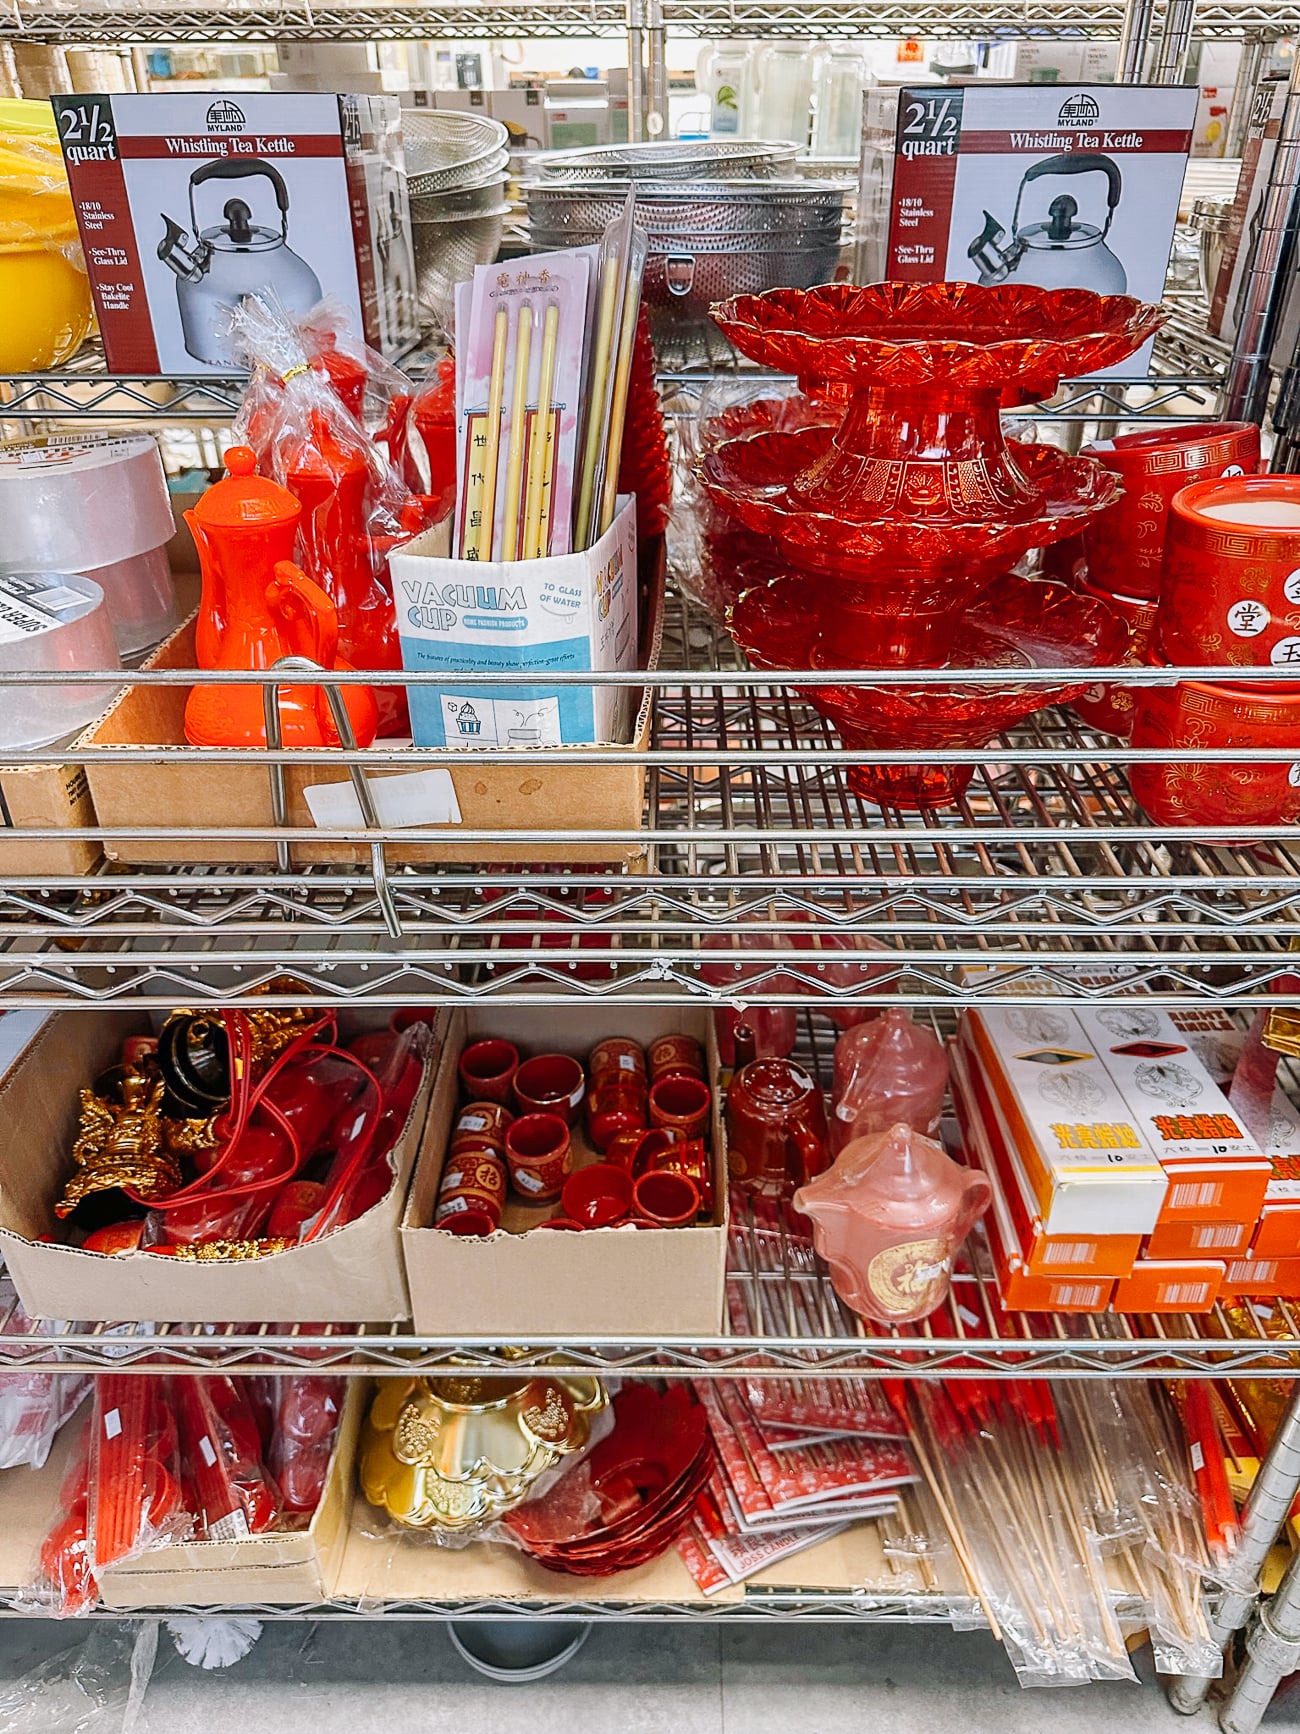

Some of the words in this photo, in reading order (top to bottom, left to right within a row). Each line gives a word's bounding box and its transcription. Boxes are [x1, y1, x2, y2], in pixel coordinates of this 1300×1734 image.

[1057, 119, 1094, 127] MYLAND
[207, 124, 243, 132] MYLAND
[1010, 132, 1073, 152] Whistling
[1076, 132, 1101, 148] Tea
[1102, 132, 1143, 148] Kettle
[165, 137, 228, 157] Whistling
[229, 137, 254, 153] Tea
[255, 137, 295, 153] Kettle
[902, 137, 955, 161] quart
[66, 143, 117, 167] quart
[81, 202, 101, 210] 18/10
[902, 198, 922, 207] 18/10
[83, 211, 115, 220] Stainless
[900, 208, 934, 217] Stainless
[85, 221, 103, 230] Steel
[899, 218, 918, 227] Steel
[91, 248, 126, 256] See-Thru
[897, 245, 934, 254] See-Thru
[94, 257, 114, 265] Glass
[115, 257, 128, 265] Lid
[897, 255, 918, 263] Glass
[920, 255, 934, 263] Lid
[99, 283, 115, 293] Stay
[116, 283, 133, 292] Cool
[101, 293, 130, 301] Bakelite
[103, 301, 130, 310] Handle
[544, 582, 556, 592] TO
[558, 585, 582, 597] GLASS
[401, 580, 527, 611] VACUUM
[539, 593, 551, 602] OF
[553, 596, 581, 609] WATER
[1, 611, 48, 632] SUPER
[407, 606, 457, 631] CUP
[1234, 603, 1263, 632] 堂
[741, 1550, 764, 1569] JOSS
[764, 1533, 801, 1555] CANDLE
